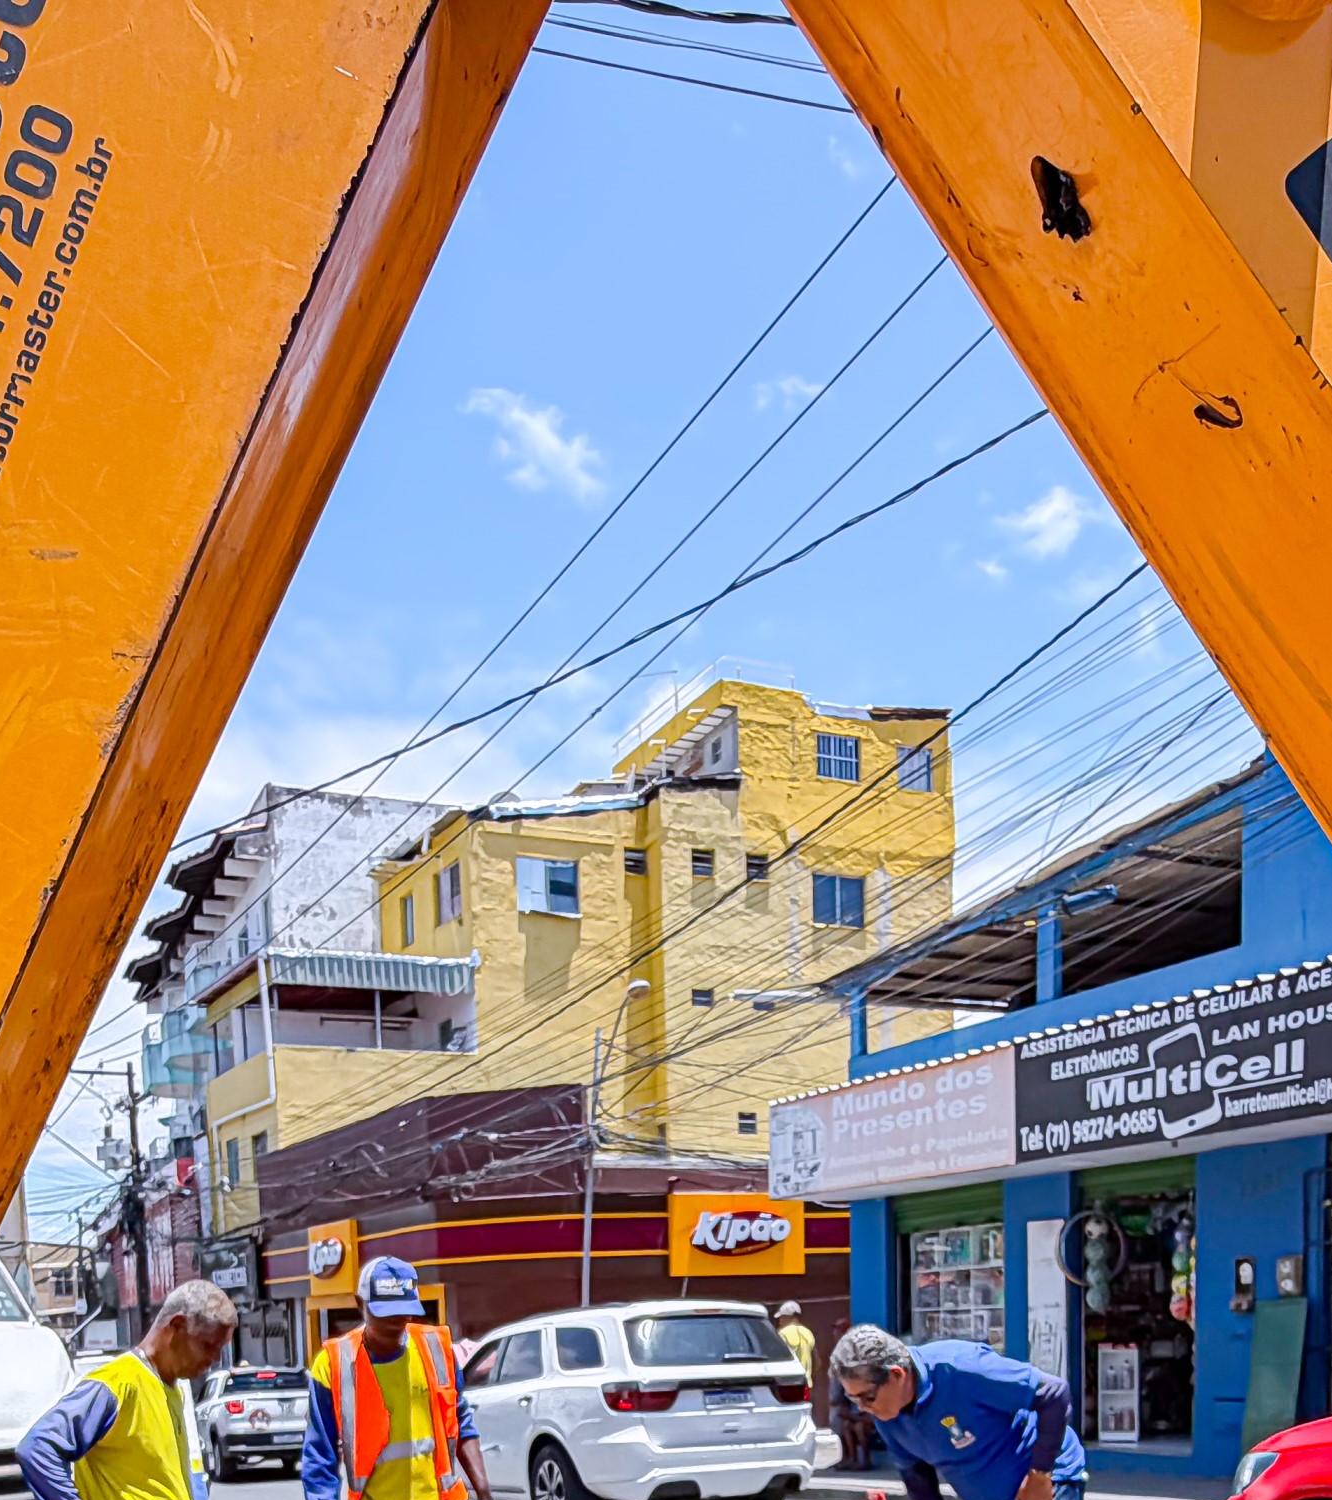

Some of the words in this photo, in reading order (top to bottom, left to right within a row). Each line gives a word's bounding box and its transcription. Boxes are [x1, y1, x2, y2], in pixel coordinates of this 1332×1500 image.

[1174, 1002, 1195, 1023] DE
[1198, 984, 1274, 1018] CELULAR
[1277, 978, 1292, 999] &
[1211, 1019, 1261, 1047] LAN
[832, 1080, 926, 1119] Mundo
[935, 1064, 994, 1095] dos
[1088, 1037, 1306, 1111] MultiCell
[832, 1094, 989, 1144] Presentes
[691, 1210, 792, 1251] Kipão
